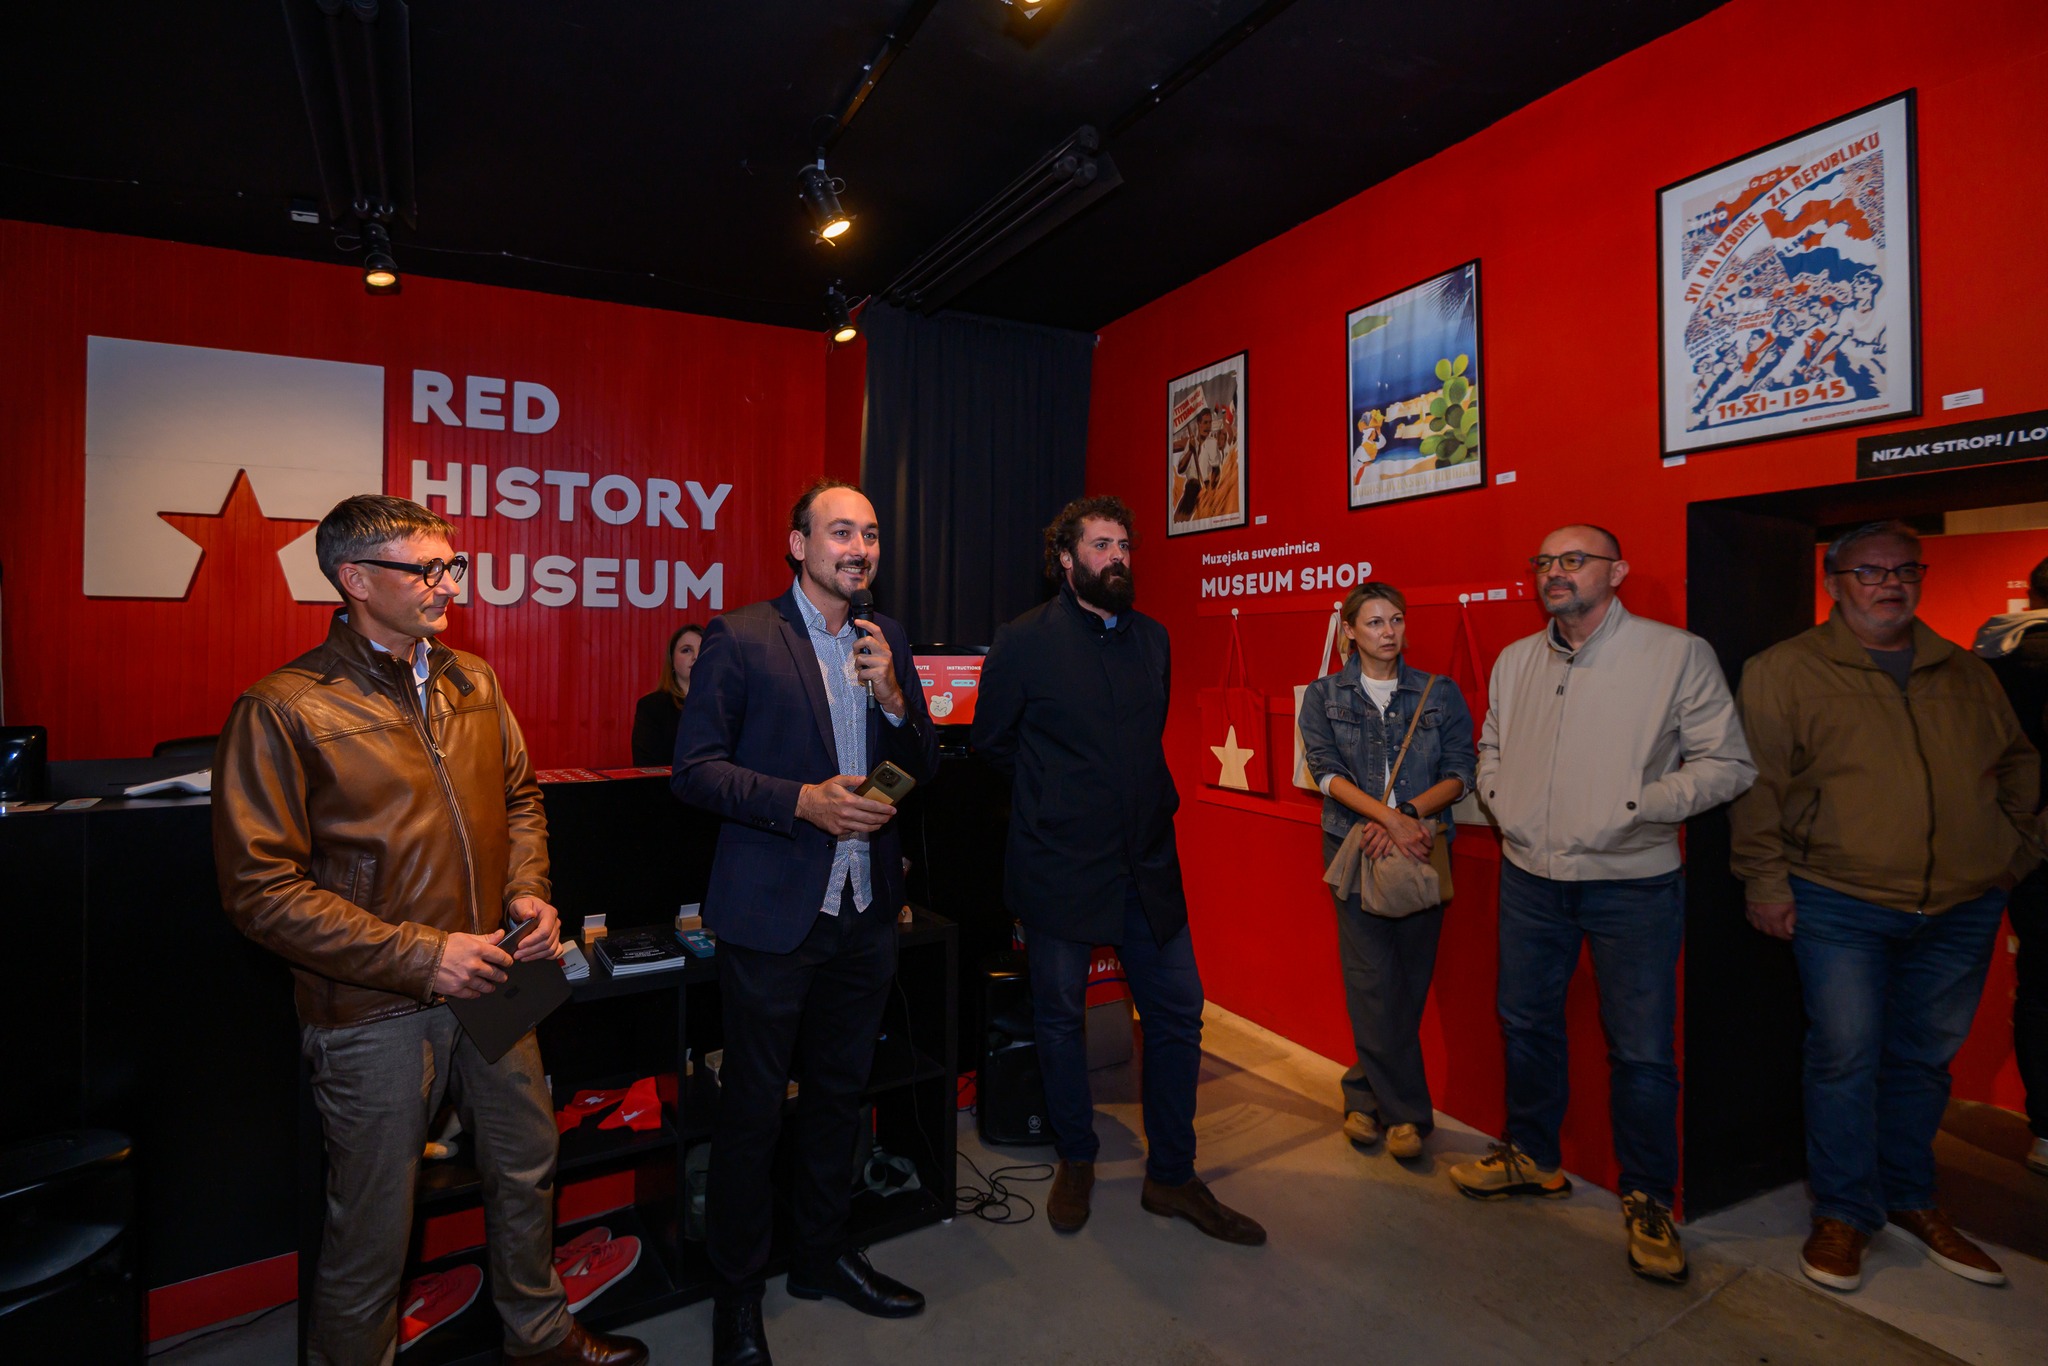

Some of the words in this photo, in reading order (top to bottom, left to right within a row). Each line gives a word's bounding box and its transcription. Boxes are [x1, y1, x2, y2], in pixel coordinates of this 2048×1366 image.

[1684, 281, 1705, 304] SVI
[1697, 259, 1720, 279] NA
[1712, 211, 1760, 258] IZBORE
[1766, 187, 1791, 208] ZA
[1793, 131, 1880, 190] REPUBLIKU
[411, 369, 560, 435] RED
[1872, 443, 1930, 463] NIZAK
[1931, 433, 2002, 455] STROP!
[411, 459, 733, 530] HISTORY
[1202, 547, 1249, 567] Muzejska
[1251, 540, 1320, 560] suvenirnica
[1201, 569, 1293, 598] MUSEUM
[1300, 562, 1373, 591] SHOP
